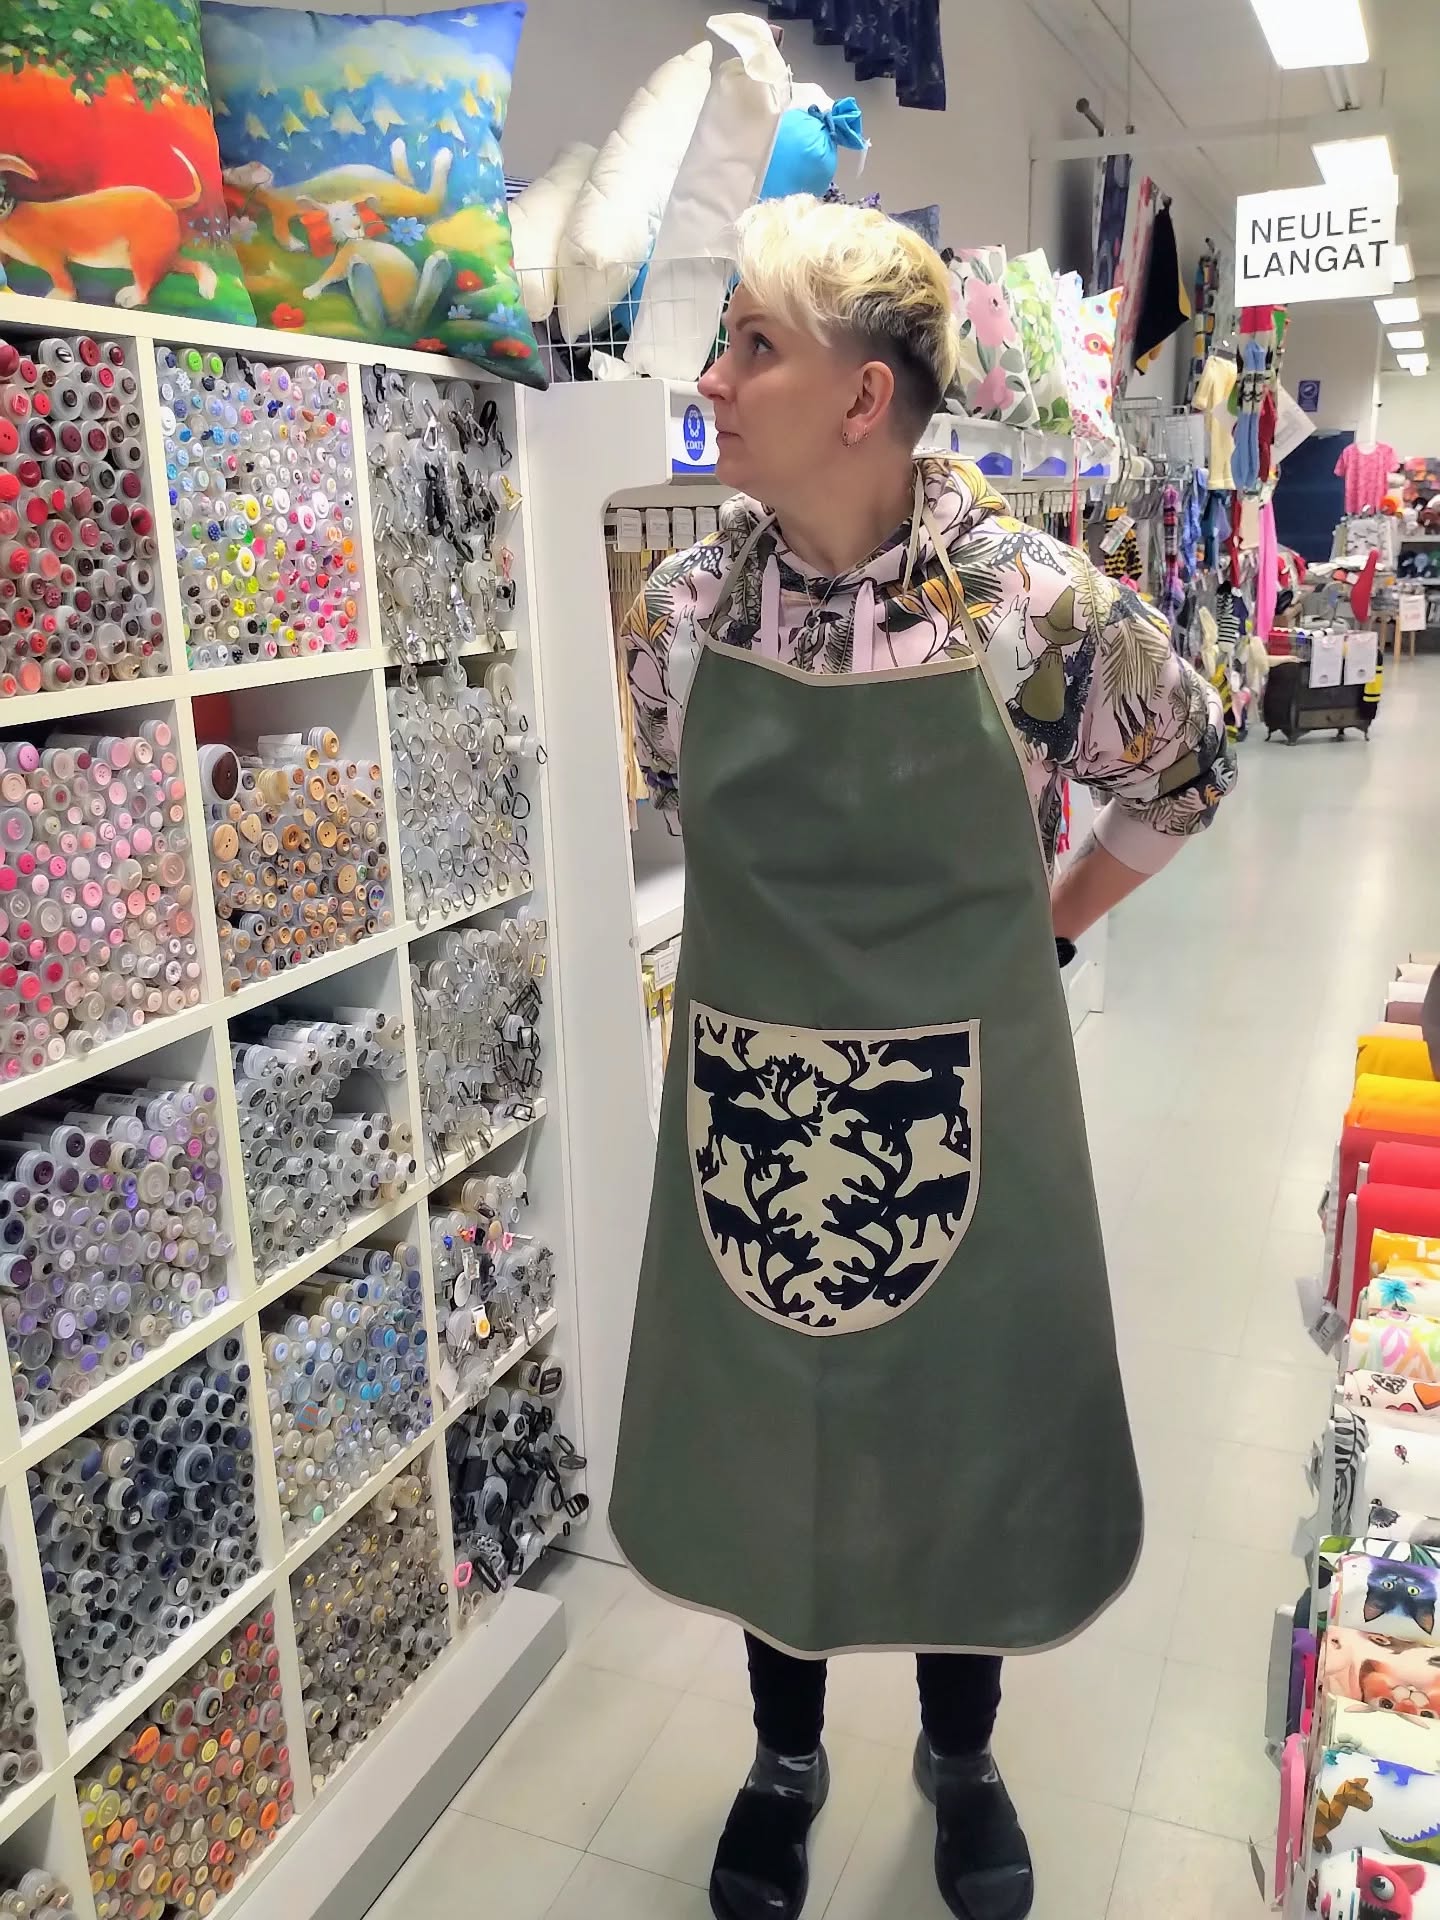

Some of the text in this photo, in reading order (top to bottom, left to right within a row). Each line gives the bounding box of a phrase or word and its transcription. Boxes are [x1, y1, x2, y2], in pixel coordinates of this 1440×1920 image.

[1251, 207, 1381, 245] NEULE-
[1243, 240, 1389, 280] LANGAT
[686, 440, 704, 450] COATS
